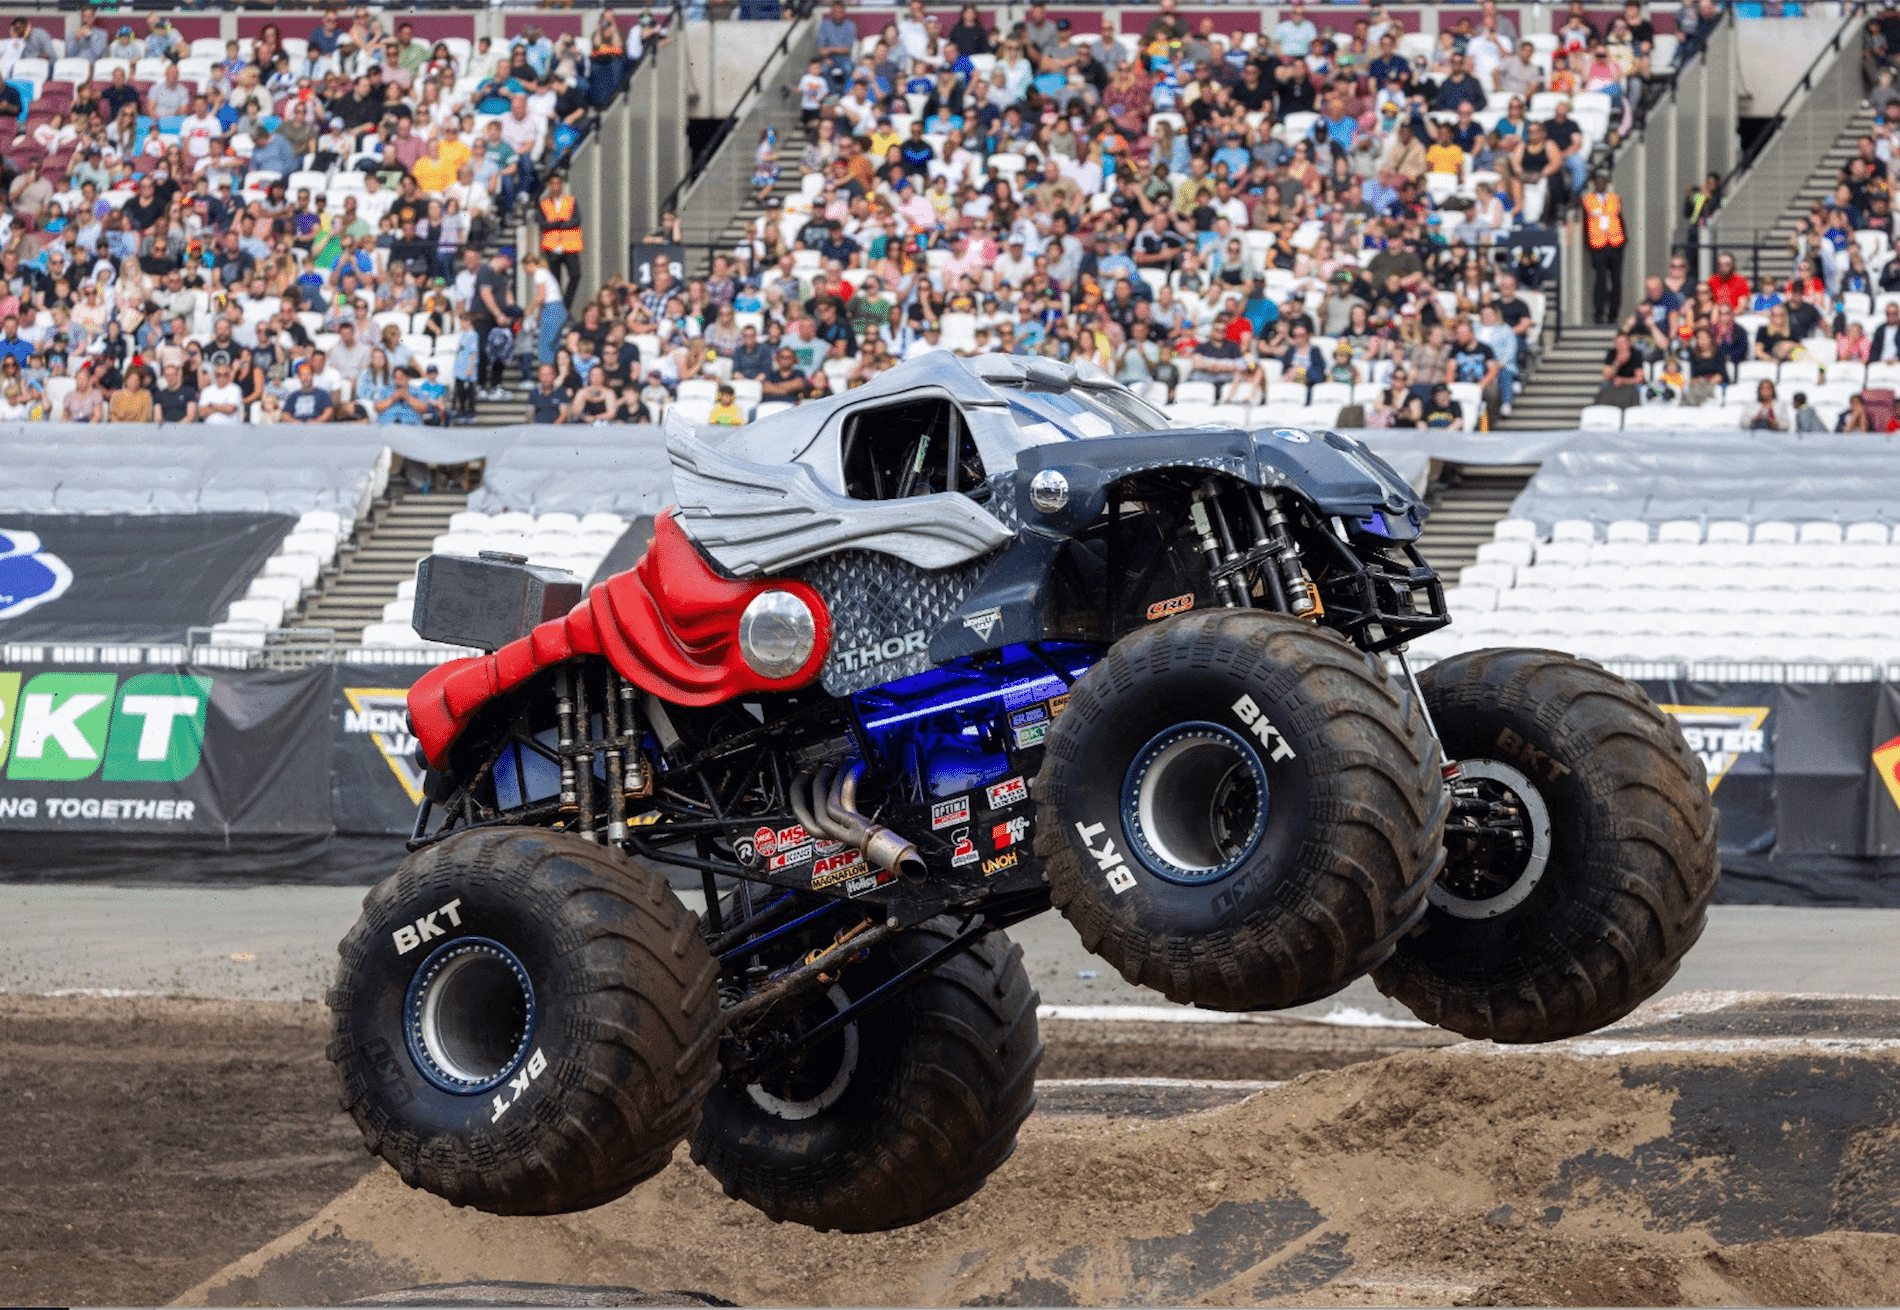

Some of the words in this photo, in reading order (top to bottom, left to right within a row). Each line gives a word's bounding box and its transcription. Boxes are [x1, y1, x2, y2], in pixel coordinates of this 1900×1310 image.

[1511, 245, 1557, 269] 17
[837, 629, 929, 671] THOR
[0, 694, 199, 761] KT
[345, 709, 410, 733] MON
[1231, 694, 1296, 763] BKT
[385, 733, 419, 755] JA
[1684, 728, 1764, 752] STER
[1497, 727, 1572, 782] BKT
[0, 798, 38, 818] NG
[45, 797, 195, 820] TOGETHER
[934, 799, 966, 818] OPTIMA
[786, 847, 812, 863] KING
[814, 850, 860, 874] ARP
[982, 852, 1018, 874] UNOH
[1075, 821, 1137, 895] BKT
[812, 862, 868, 888] MAGNAFLOW
[848, 876, 877, 893] Holley
[392, 899, 462, 955] BKT
[491, 1047, 548, 1124] BKT
